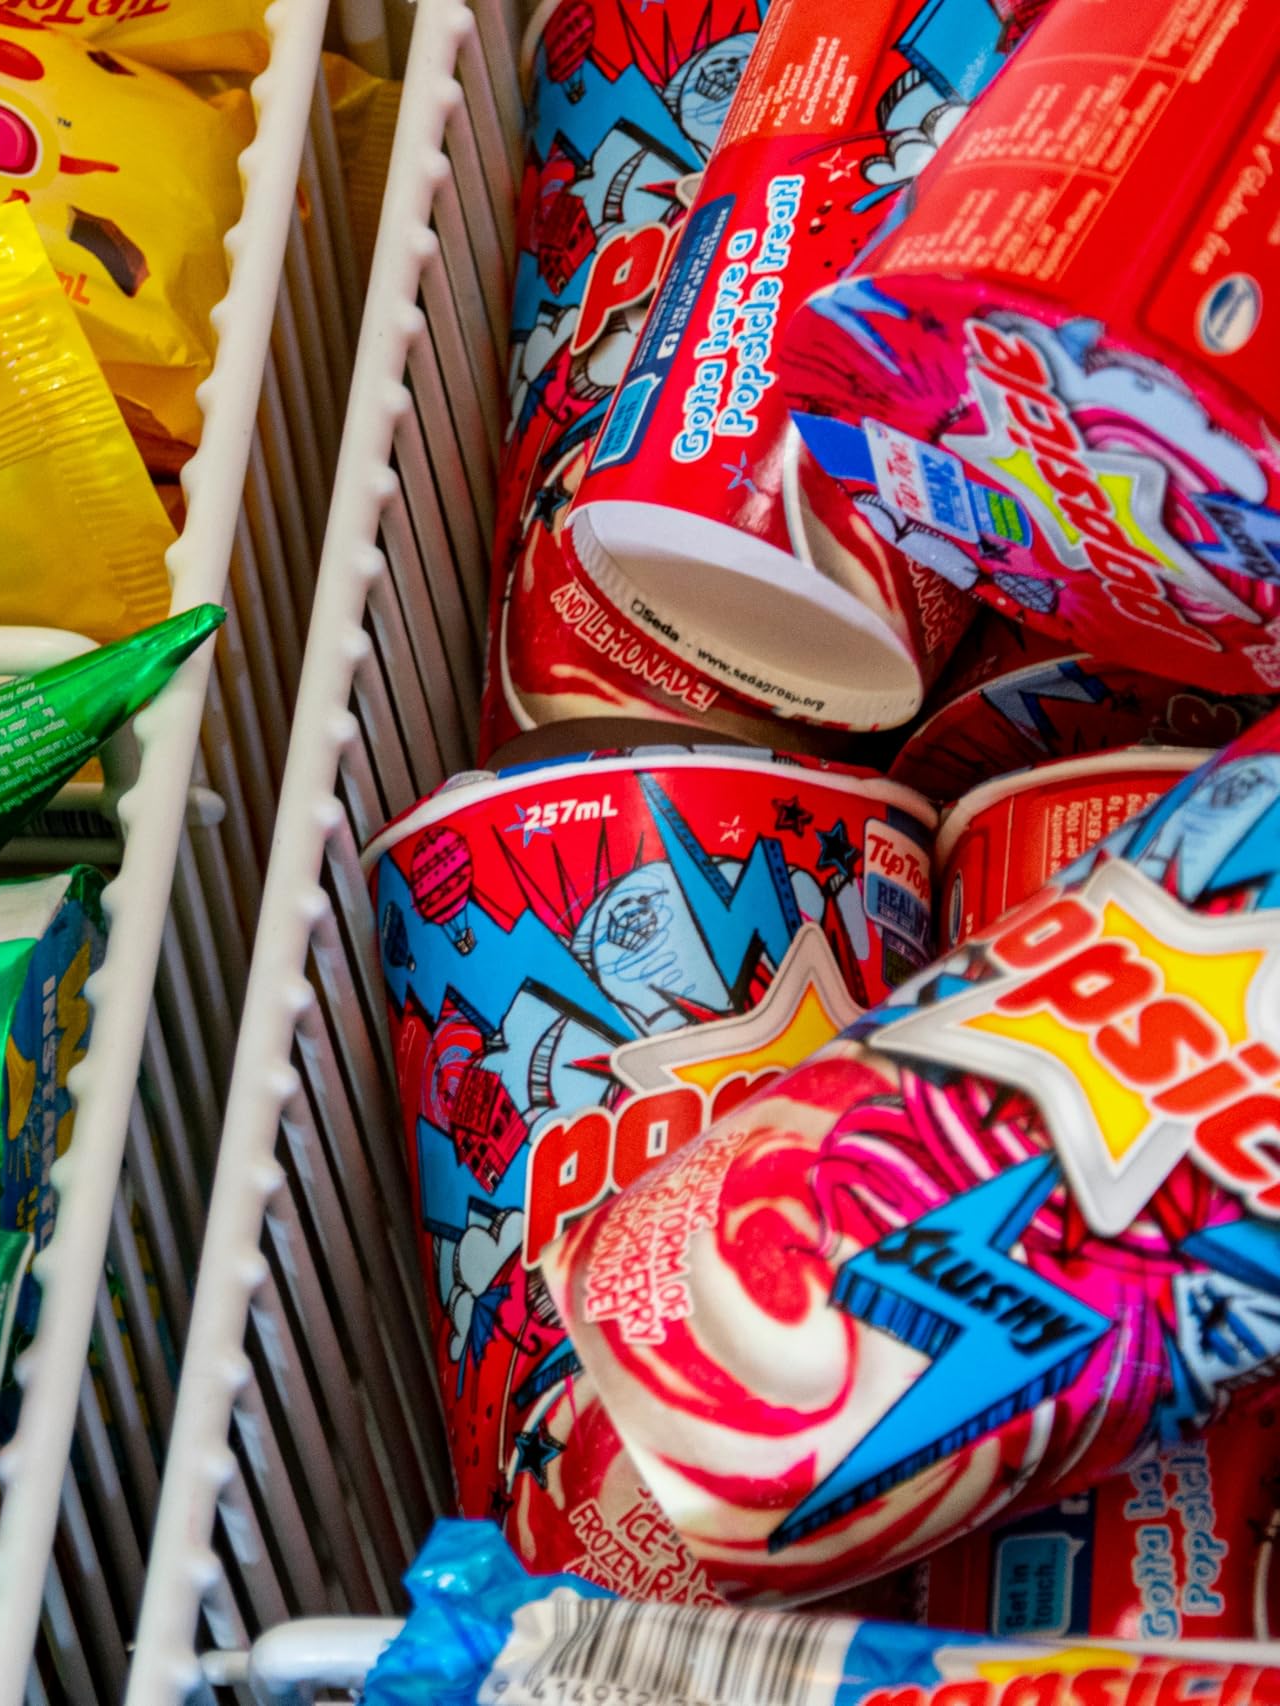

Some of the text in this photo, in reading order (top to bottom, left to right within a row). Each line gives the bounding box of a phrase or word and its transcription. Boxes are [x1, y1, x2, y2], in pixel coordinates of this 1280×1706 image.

[827, 72, 864, 127] Sodium
[725, 229, 756, 262] a
[695, 264, 752, 360] have
[716, 173, 805, 437] Popsicle treat!
[671, 354, 724, 463] Gotta
[579, 603, 720, 712] LEMONADE!
[642, 604, 680, 644] Seda
[523, 796, 619, 830] 257mL
[863, 832, 908, 878] Tip
[569, 1501, 649, 1579] FROZEN
[1125, 1448, 1179, 1641] Gotta ha
